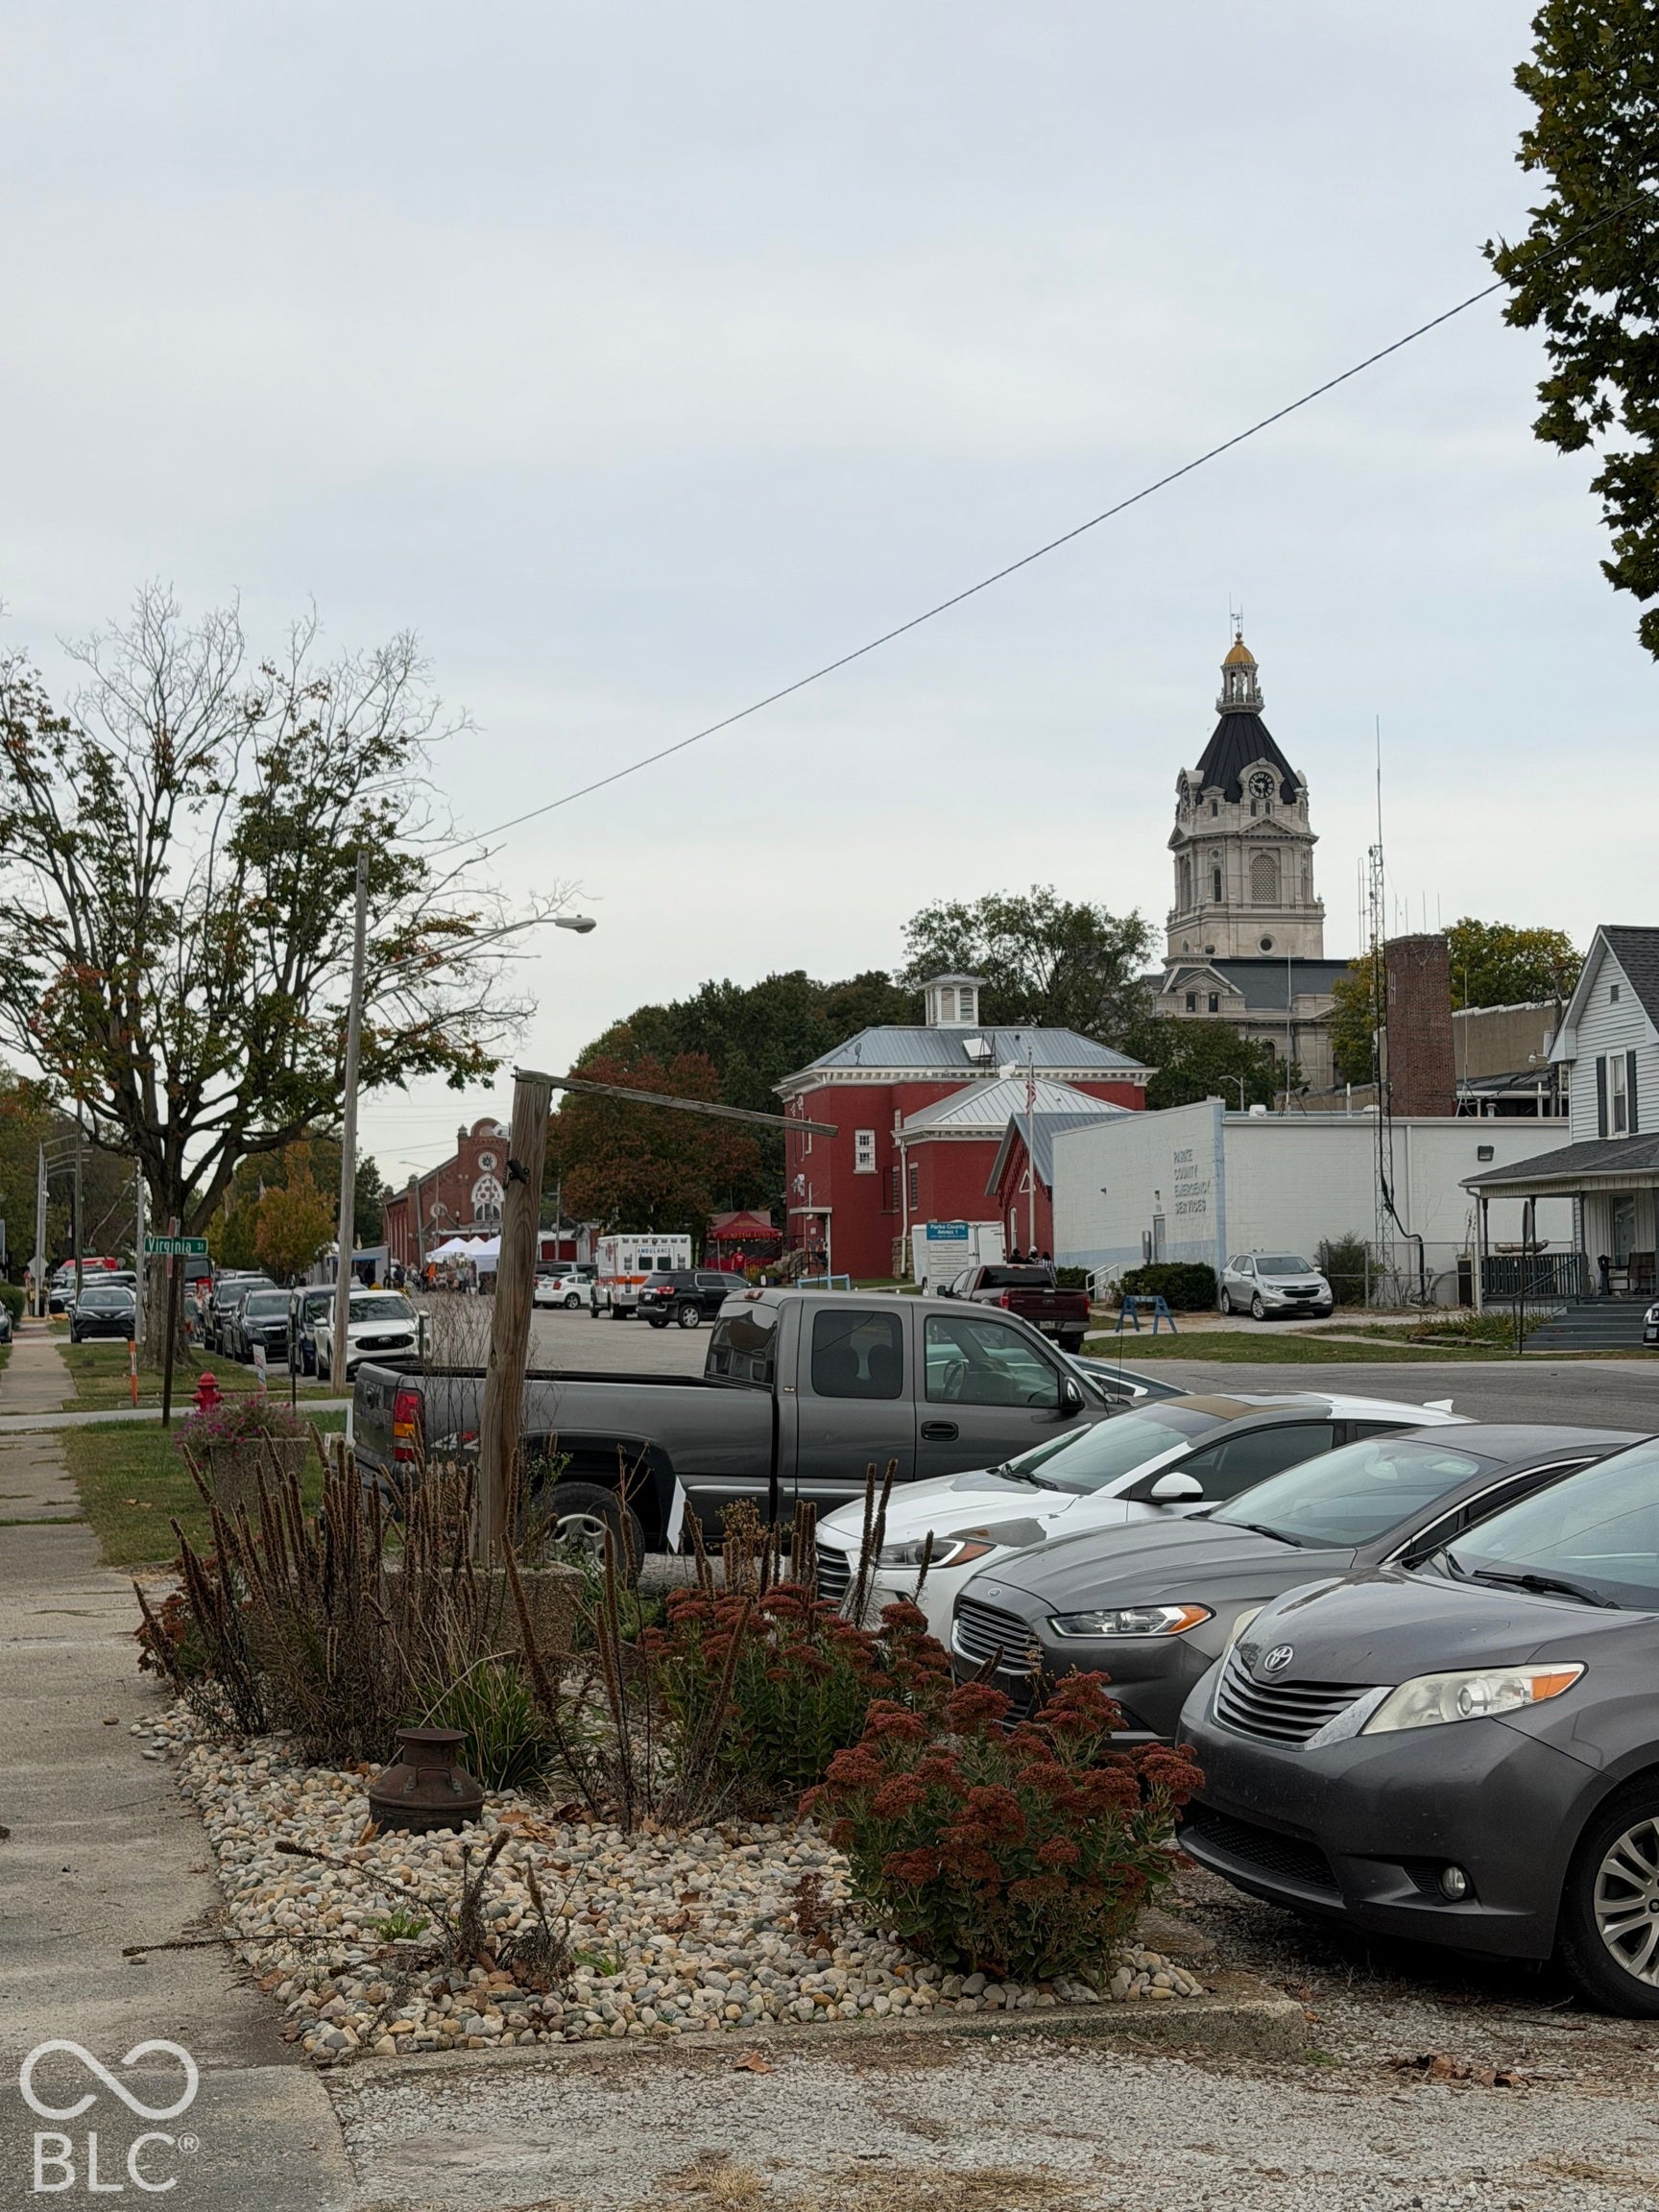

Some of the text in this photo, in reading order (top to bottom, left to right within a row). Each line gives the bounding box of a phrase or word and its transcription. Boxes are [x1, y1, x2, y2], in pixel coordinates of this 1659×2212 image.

[1174, 1165, 1198, 1181] COUNTY
[1174, 1180, 1211, 1198] EMERGENCY
[1174, 1199, 1207, 1214] SERVICES
[148, 1237, 192, 1254] Virginia
